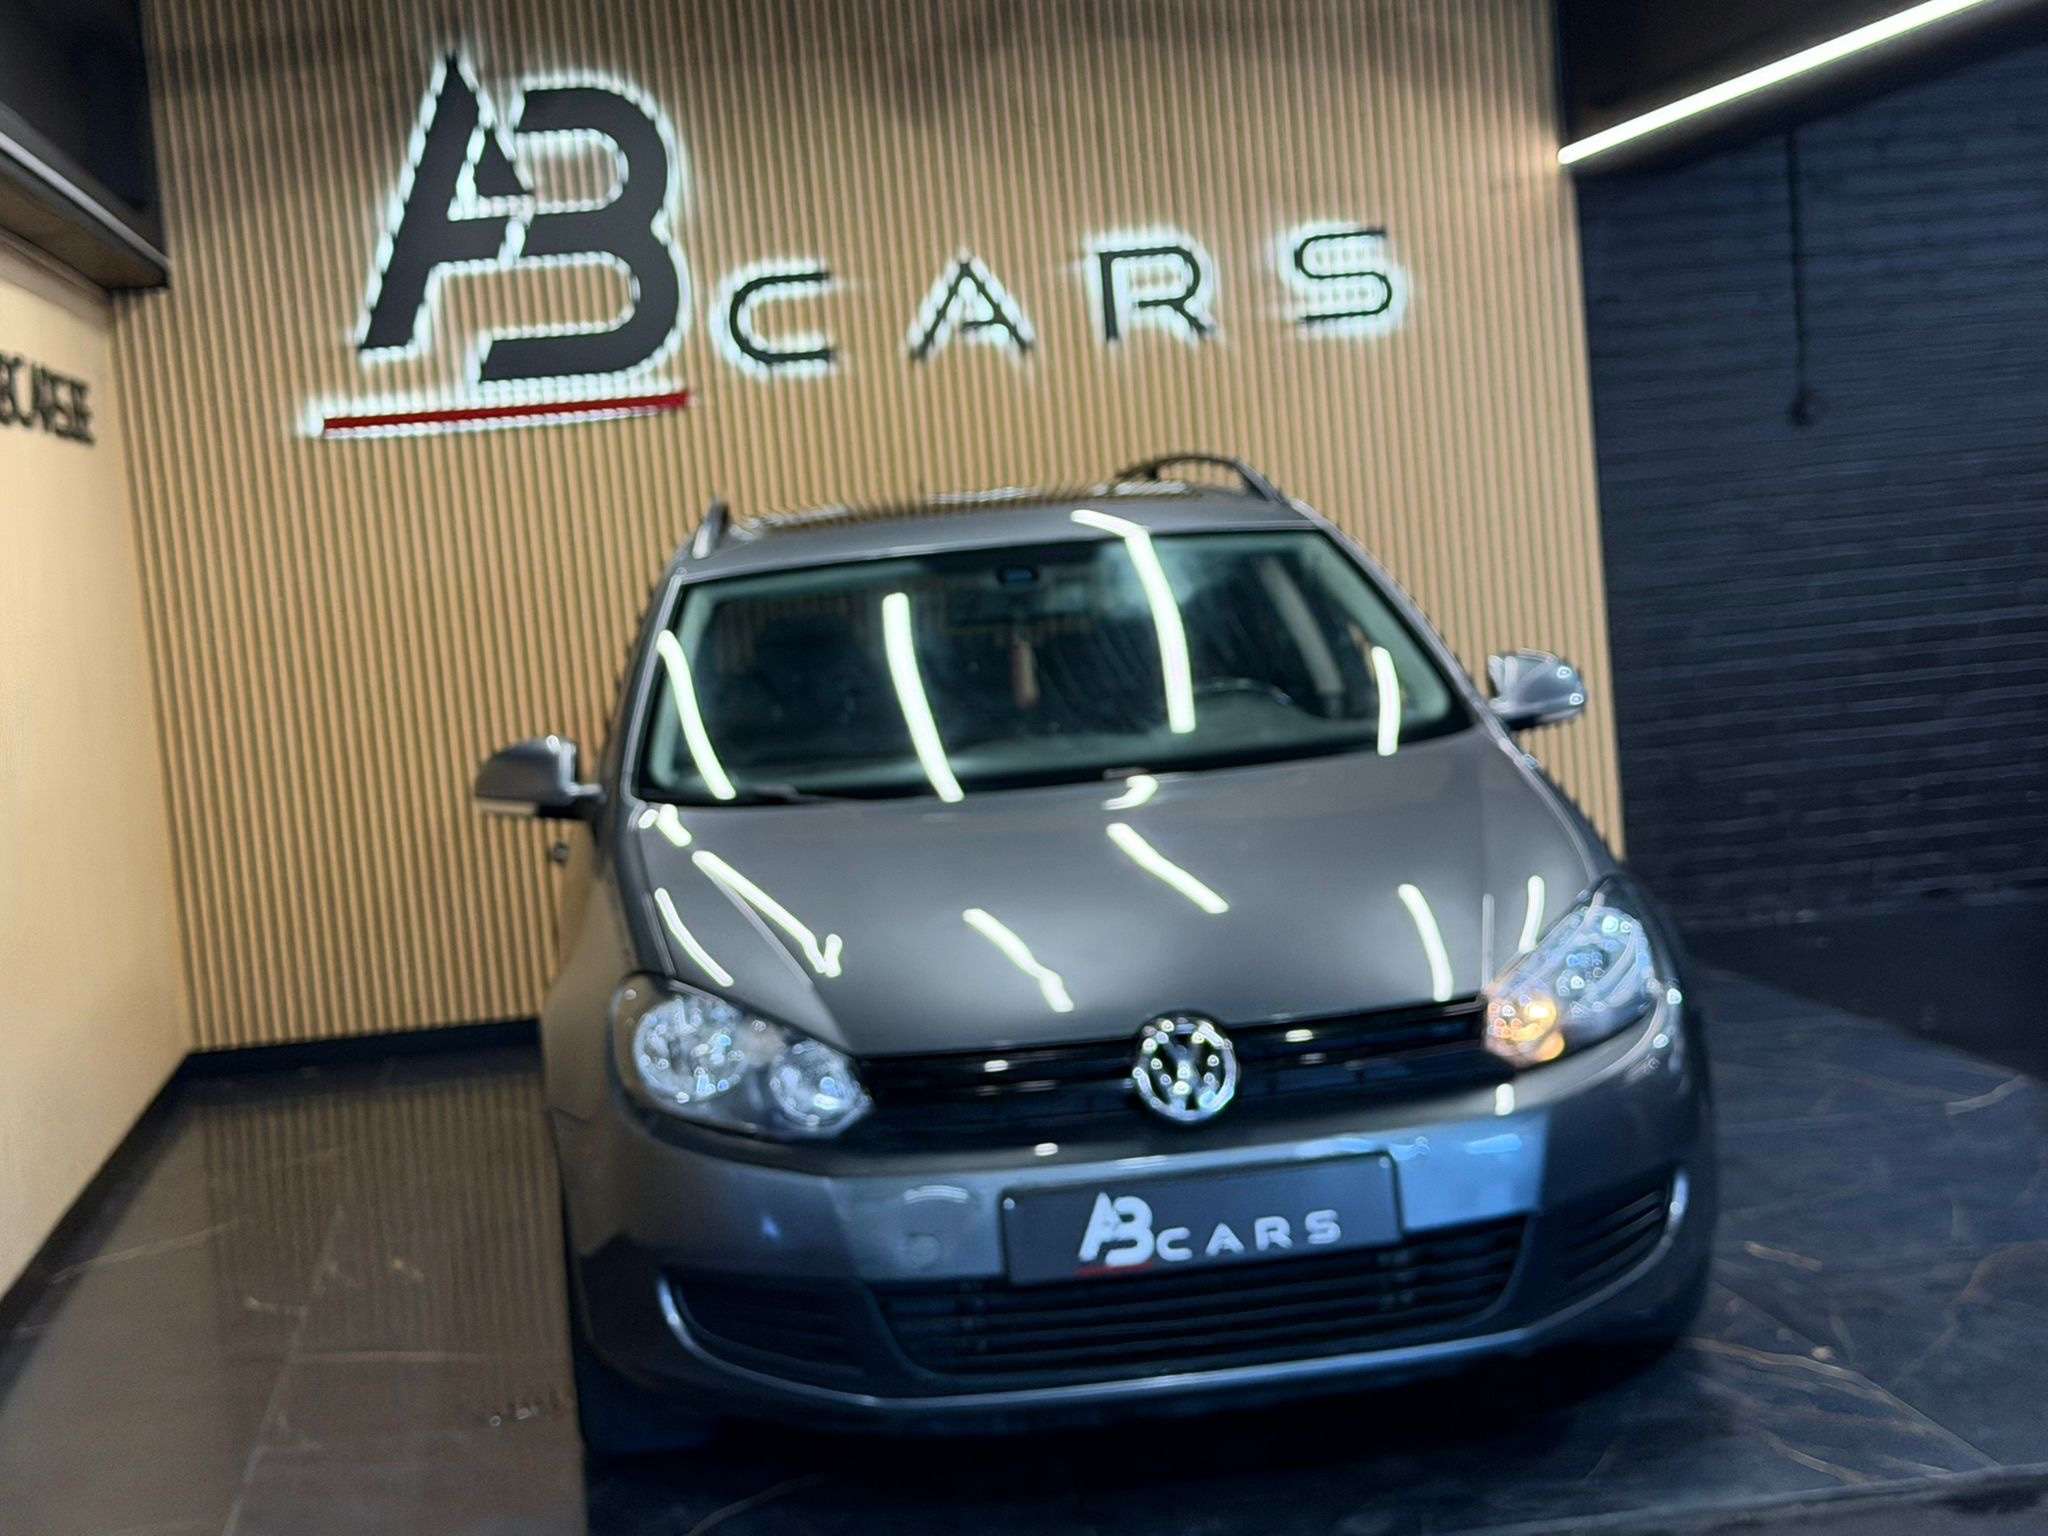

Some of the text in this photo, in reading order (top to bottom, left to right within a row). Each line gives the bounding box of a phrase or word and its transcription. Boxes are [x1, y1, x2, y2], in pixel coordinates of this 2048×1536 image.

[357, 52, 1394, 382] AB CARS
[1079, 1192, 1341, 1266] AB CARS
